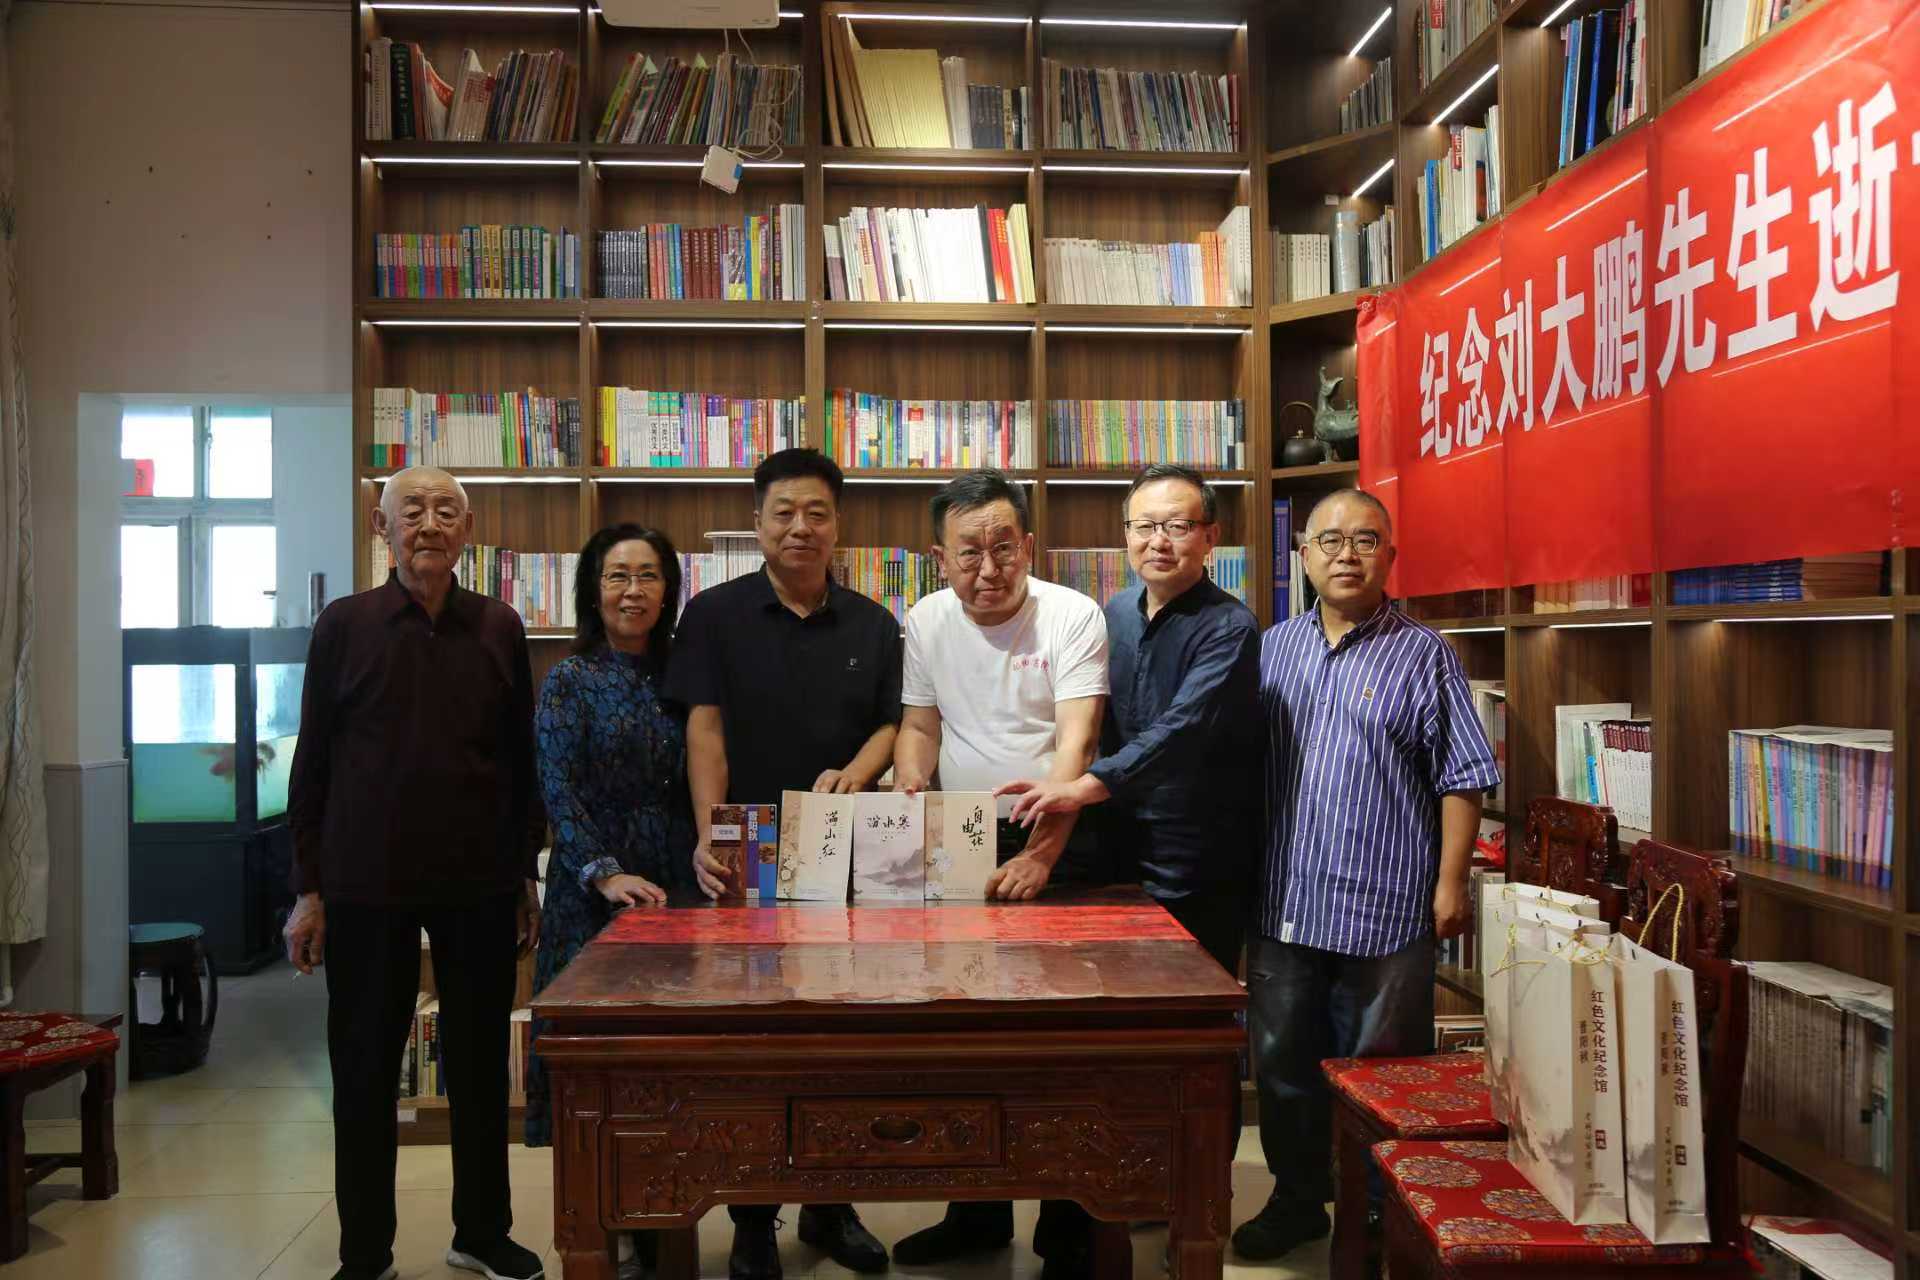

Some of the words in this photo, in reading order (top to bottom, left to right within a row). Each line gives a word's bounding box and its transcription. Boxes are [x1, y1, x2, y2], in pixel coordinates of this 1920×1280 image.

[1419, 81, 1919, 459] 纪念刘大鹏先生逝
[1591, 990, 1608, 1094] 红色文化纪念馆
[1671, 1000, 1689, 1108] 红色文化纪念馆
